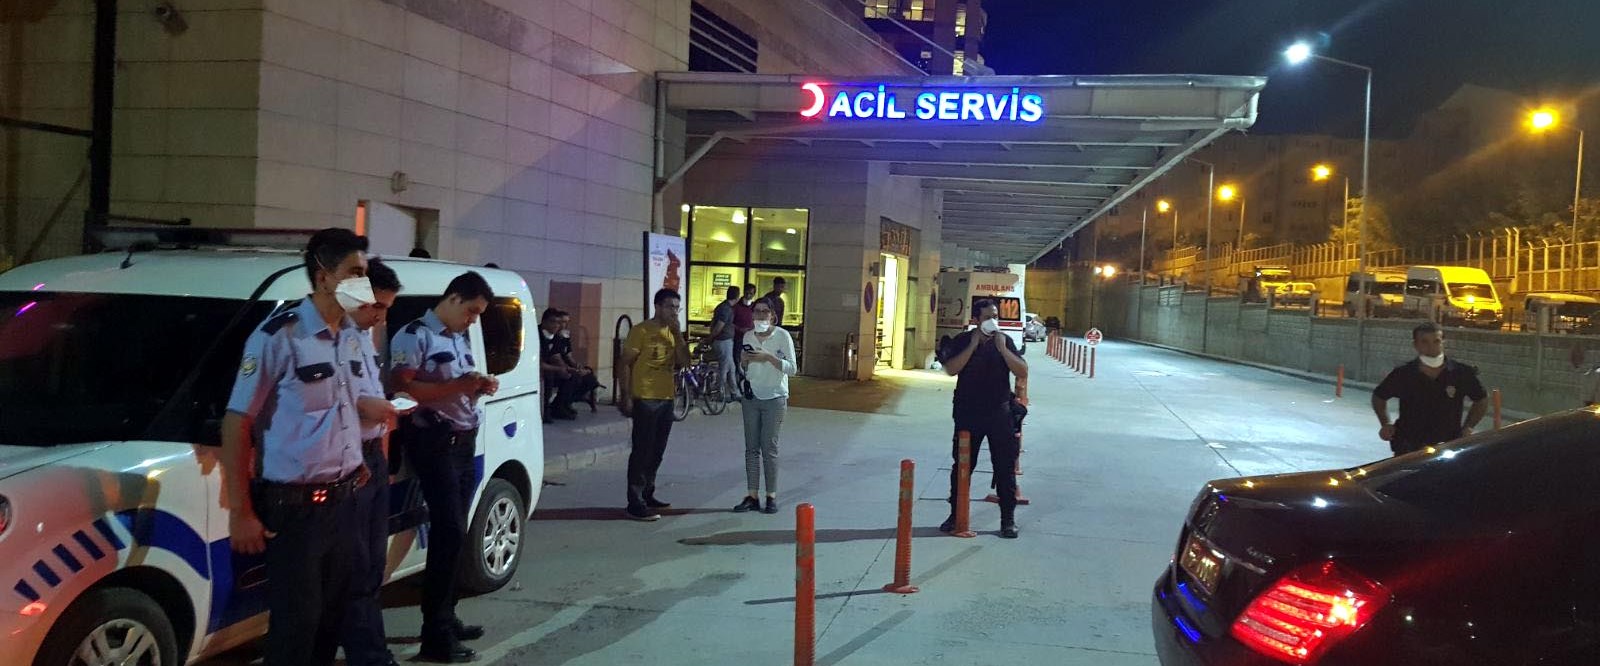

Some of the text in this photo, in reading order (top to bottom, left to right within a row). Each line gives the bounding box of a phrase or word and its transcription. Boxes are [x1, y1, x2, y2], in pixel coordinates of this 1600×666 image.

[829, 85, 1043, 122] ACİL SERVİS
[975, 283, 1015, 292] AMBULANS
[999, 298, 1019, 319] 112
